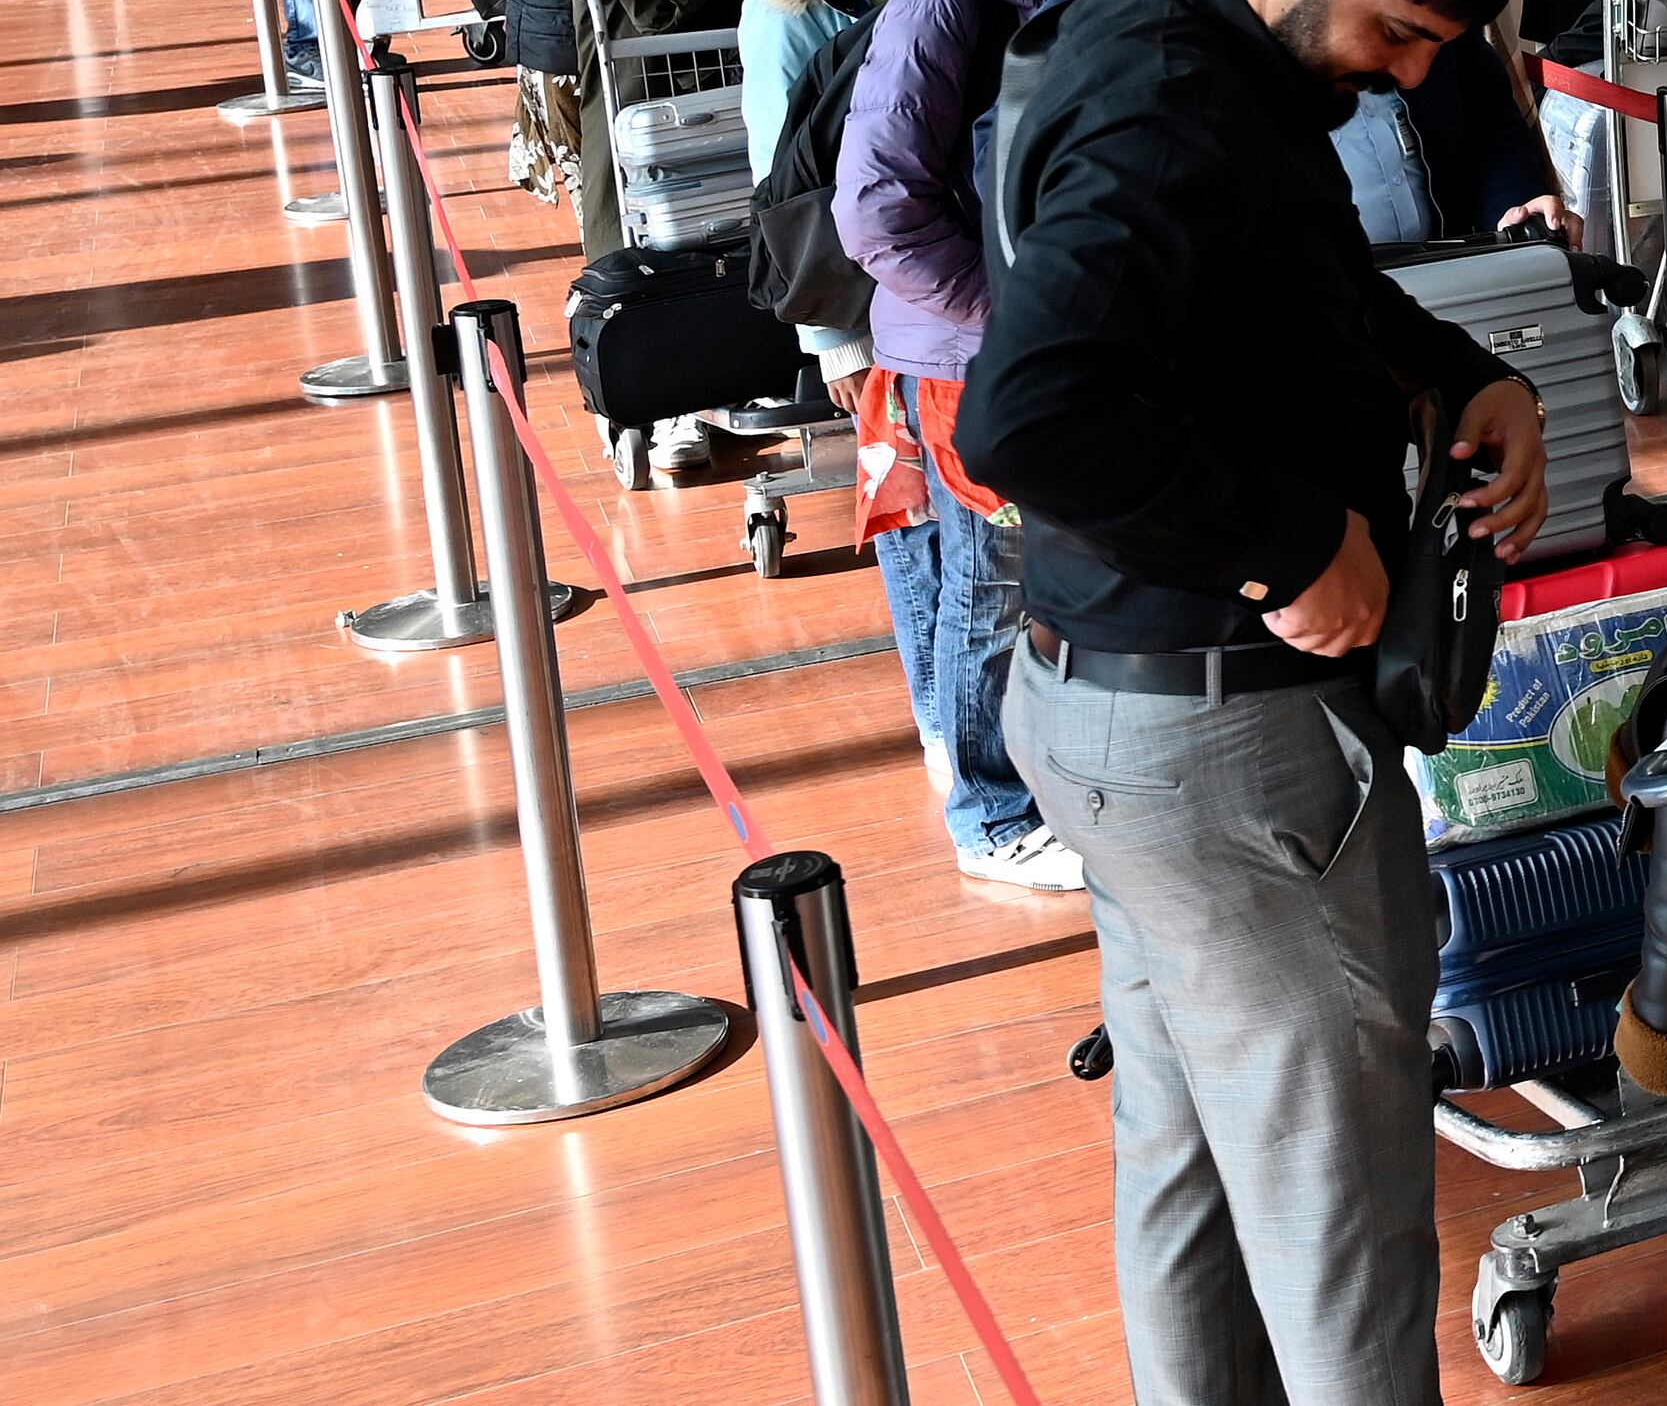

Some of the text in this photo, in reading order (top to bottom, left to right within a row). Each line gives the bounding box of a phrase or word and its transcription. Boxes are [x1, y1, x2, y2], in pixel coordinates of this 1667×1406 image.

[1505, 678, 1544, 724] Product of
[1519, 690, 1551, 729] Pakistan
